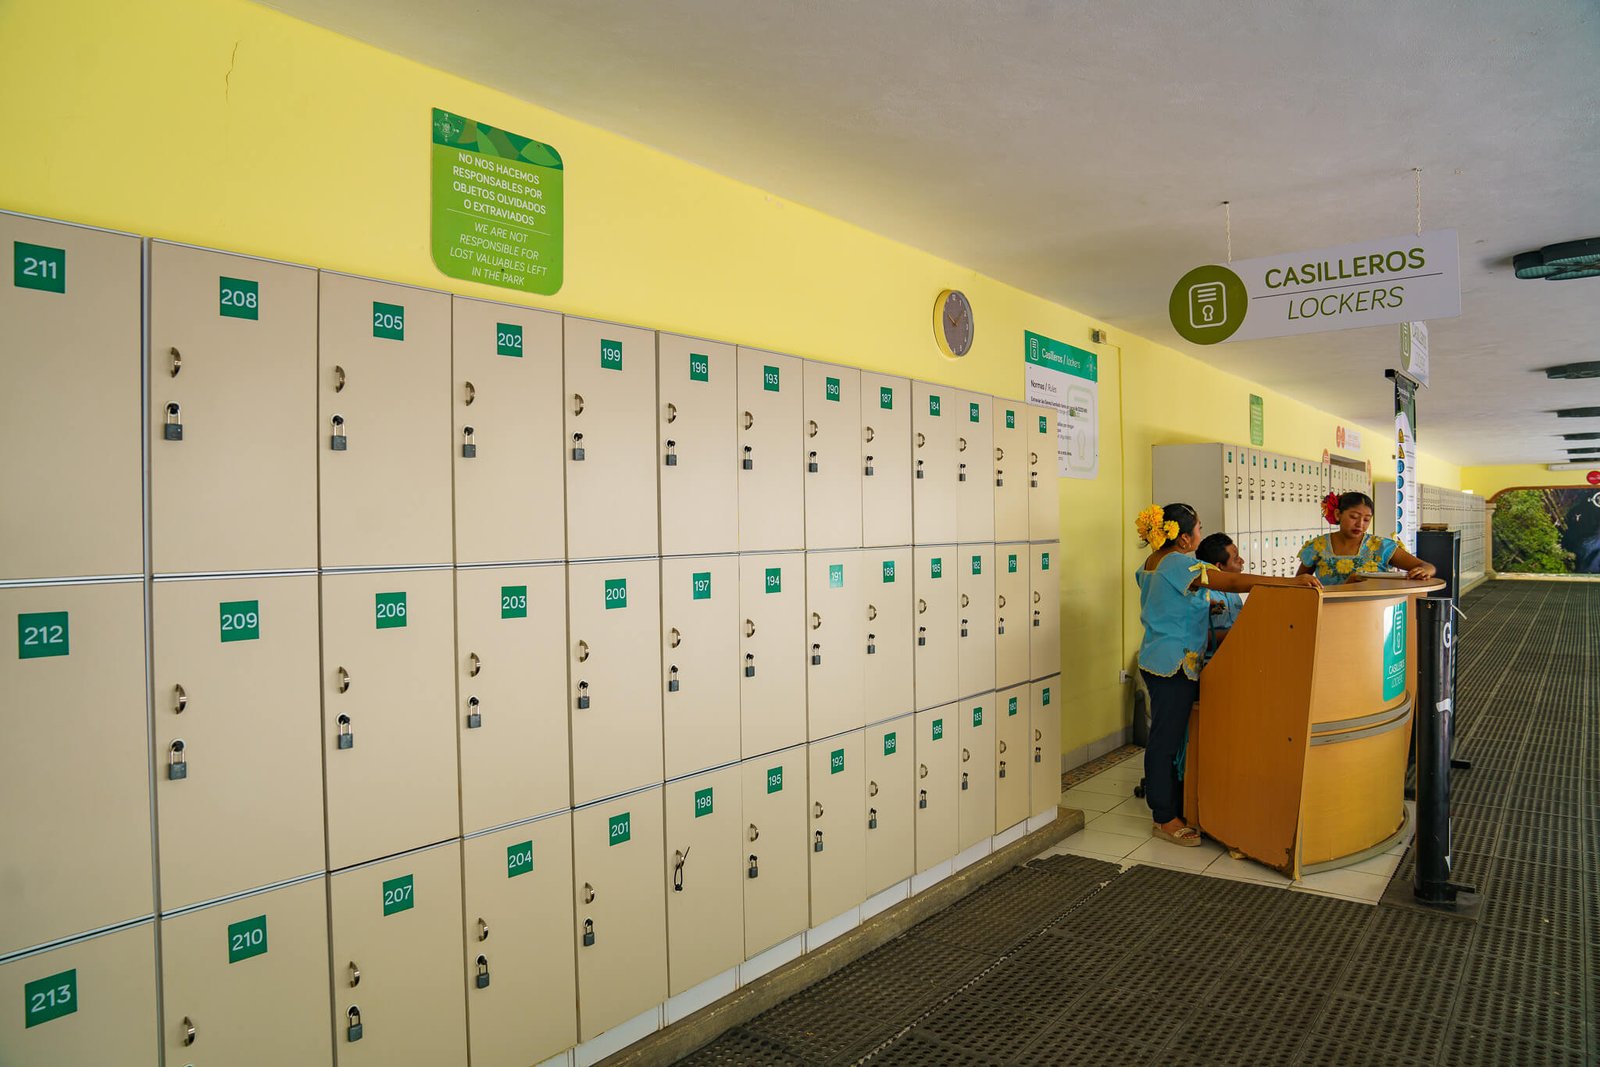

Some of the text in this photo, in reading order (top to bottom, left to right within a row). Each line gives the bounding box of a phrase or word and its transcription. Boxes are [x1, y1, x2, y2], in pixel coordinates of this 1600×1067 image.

[458, 153, 540, 184] NO NOS HACEMOS
[453, 165, 542, 199] RESPONSABLES POR
[453, 181, 546, 215] OBJETOS OLVIDADOS
[463, 200, 535, 226] O EXTRAVIADOS
[474, 222, 529, 243] WE ARE NOT
[459, 234, 539, 261] RESPONSIBLE FOR
[23, 258, 56, 279] 211
[449, 246, 548, 276] LOST VALUABLES LEFT
[1264, 247, 1425, 289] CASILLEROS
[471, 266, 525, 286] IN THE PARK
[222, 289, 256, 308] 208
[1287, 286, 1405, 320] LOCKERS
[376, 313, 402, 330] 205
[498, 333, 521, 348] 202
[603, 348, 620, 361] 199
[1041, 348, 1063, 364] Casilleros
[692, 362, 706, 373] 196
[766, 374, 778, 384] 193
[1031, 379, 1044, 390] Normas
[827, 384, 838, 394] 190
[882, 394, 891, 402] 187
[832, 572, 841, 582] 191
[884, 567, 893, 576] 188
[695, 580, 709, 591] 197
[767, 576, 779, 585] 194
[606, 588, 625, 600] 200
[378, 603, 404, 618] 206
[503, 596, 526, 609] 203
[223, 613, 257, 630] 209
[25, 626, 63, 645] 212
[886, 739, 895, 748] 189
[832, 756, 843, 767] 192
[769, 774, 781, 786] 195
[697, 796, 711, 808] 198
[612, 822, 628, 837] 201
[509, 851, 531, 868] 204
[385, 885, 411, 905] 207
[233, 929, 263, 950] 210
[32, 985, 70, 1012] 213
